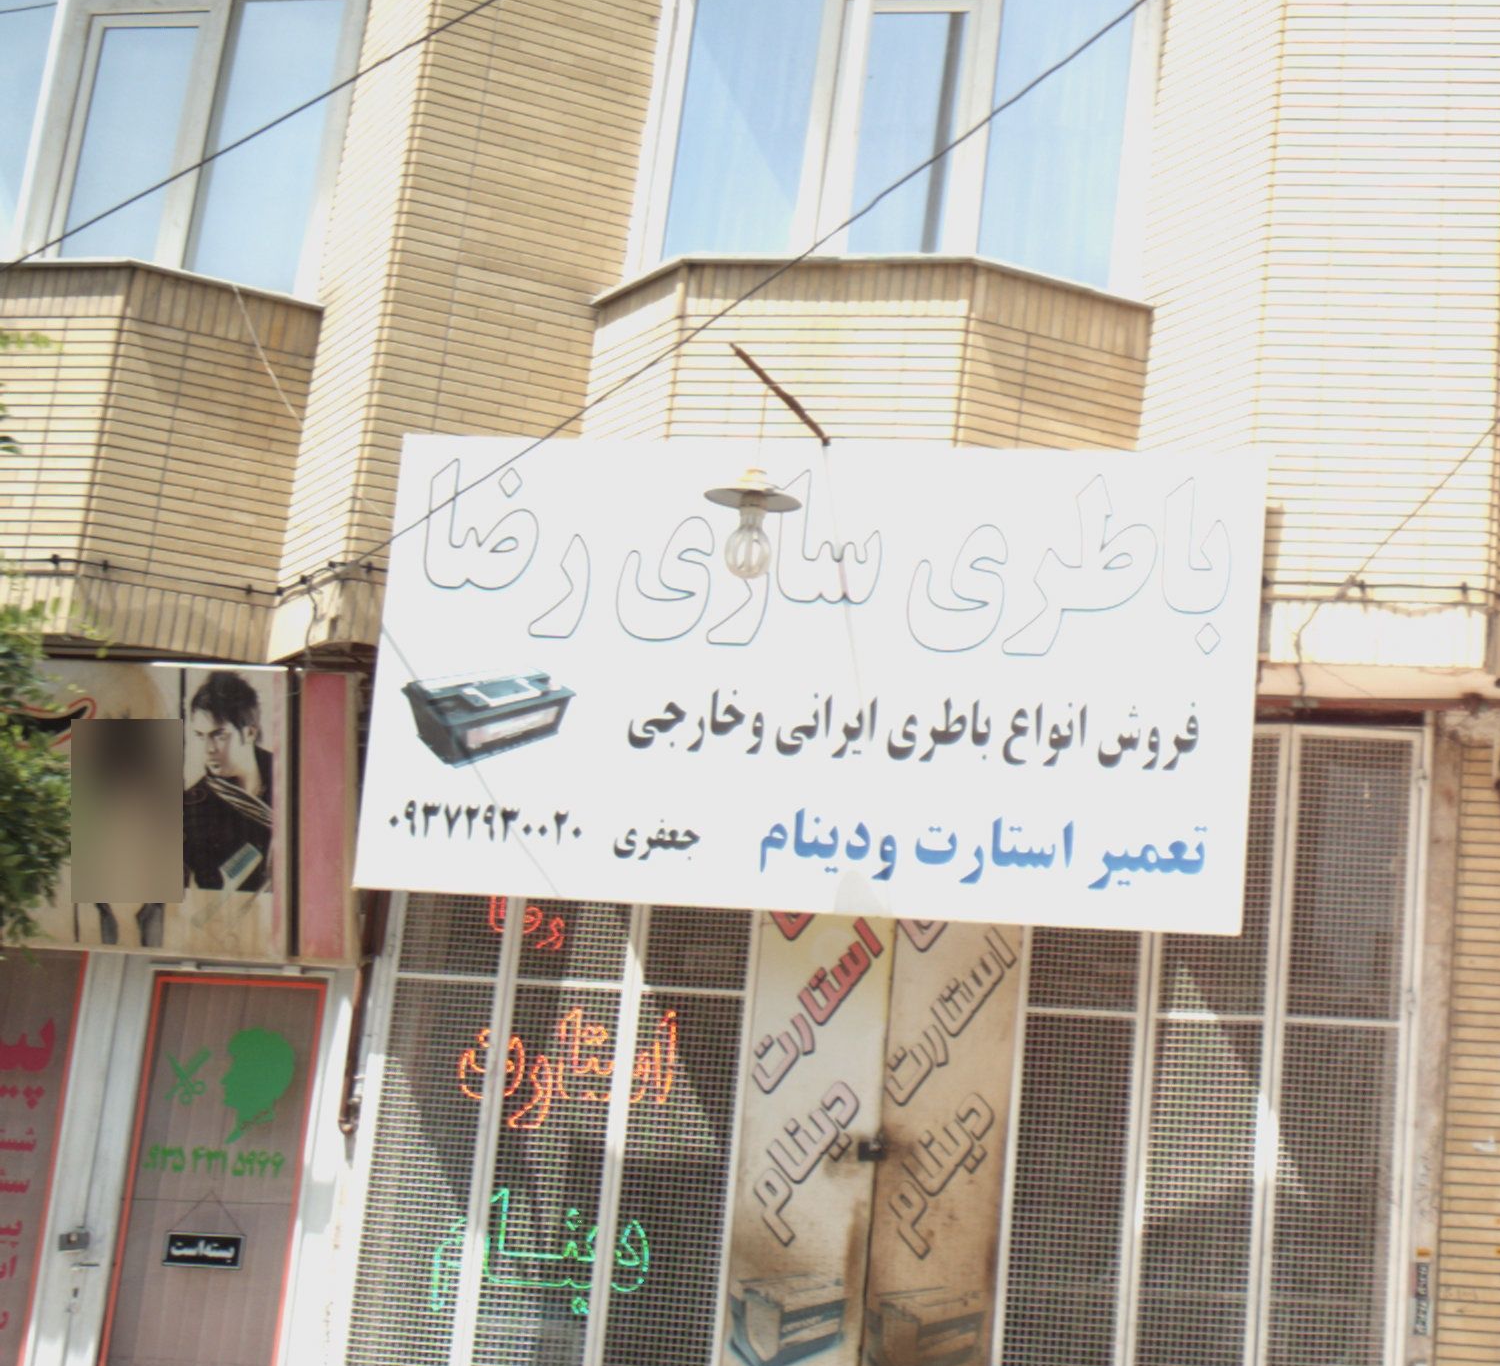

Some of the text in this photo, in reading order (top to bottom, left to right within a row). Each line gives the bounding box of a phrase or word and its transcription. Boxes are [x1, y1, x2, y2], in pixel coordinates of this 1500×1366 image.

[424, 458, 591, 638] رضا
[906, 473, 1231, 656] باطری
[775, 692, 877, 758] ایرانی
[887, 696, 991, 762] باطری
[1002, 701, 1087, 766] انواع
[1097, 701, 1200, 771] فروش
[389, 800, 582, 845] ۰۹۳۷۲۹۳۰۰۲۰
[613, 819, 700, 860] جعفری
[914, 816, 1074, 884] استارت
[1087, 825, 1208, 890] تعمیر
[751, 916, 884, 1095] استارت
[885, 926, 1017, 1106] استارت
[752, 1080, 860, 1247] دینام
[889, 1092, 995, 1260] دینام
